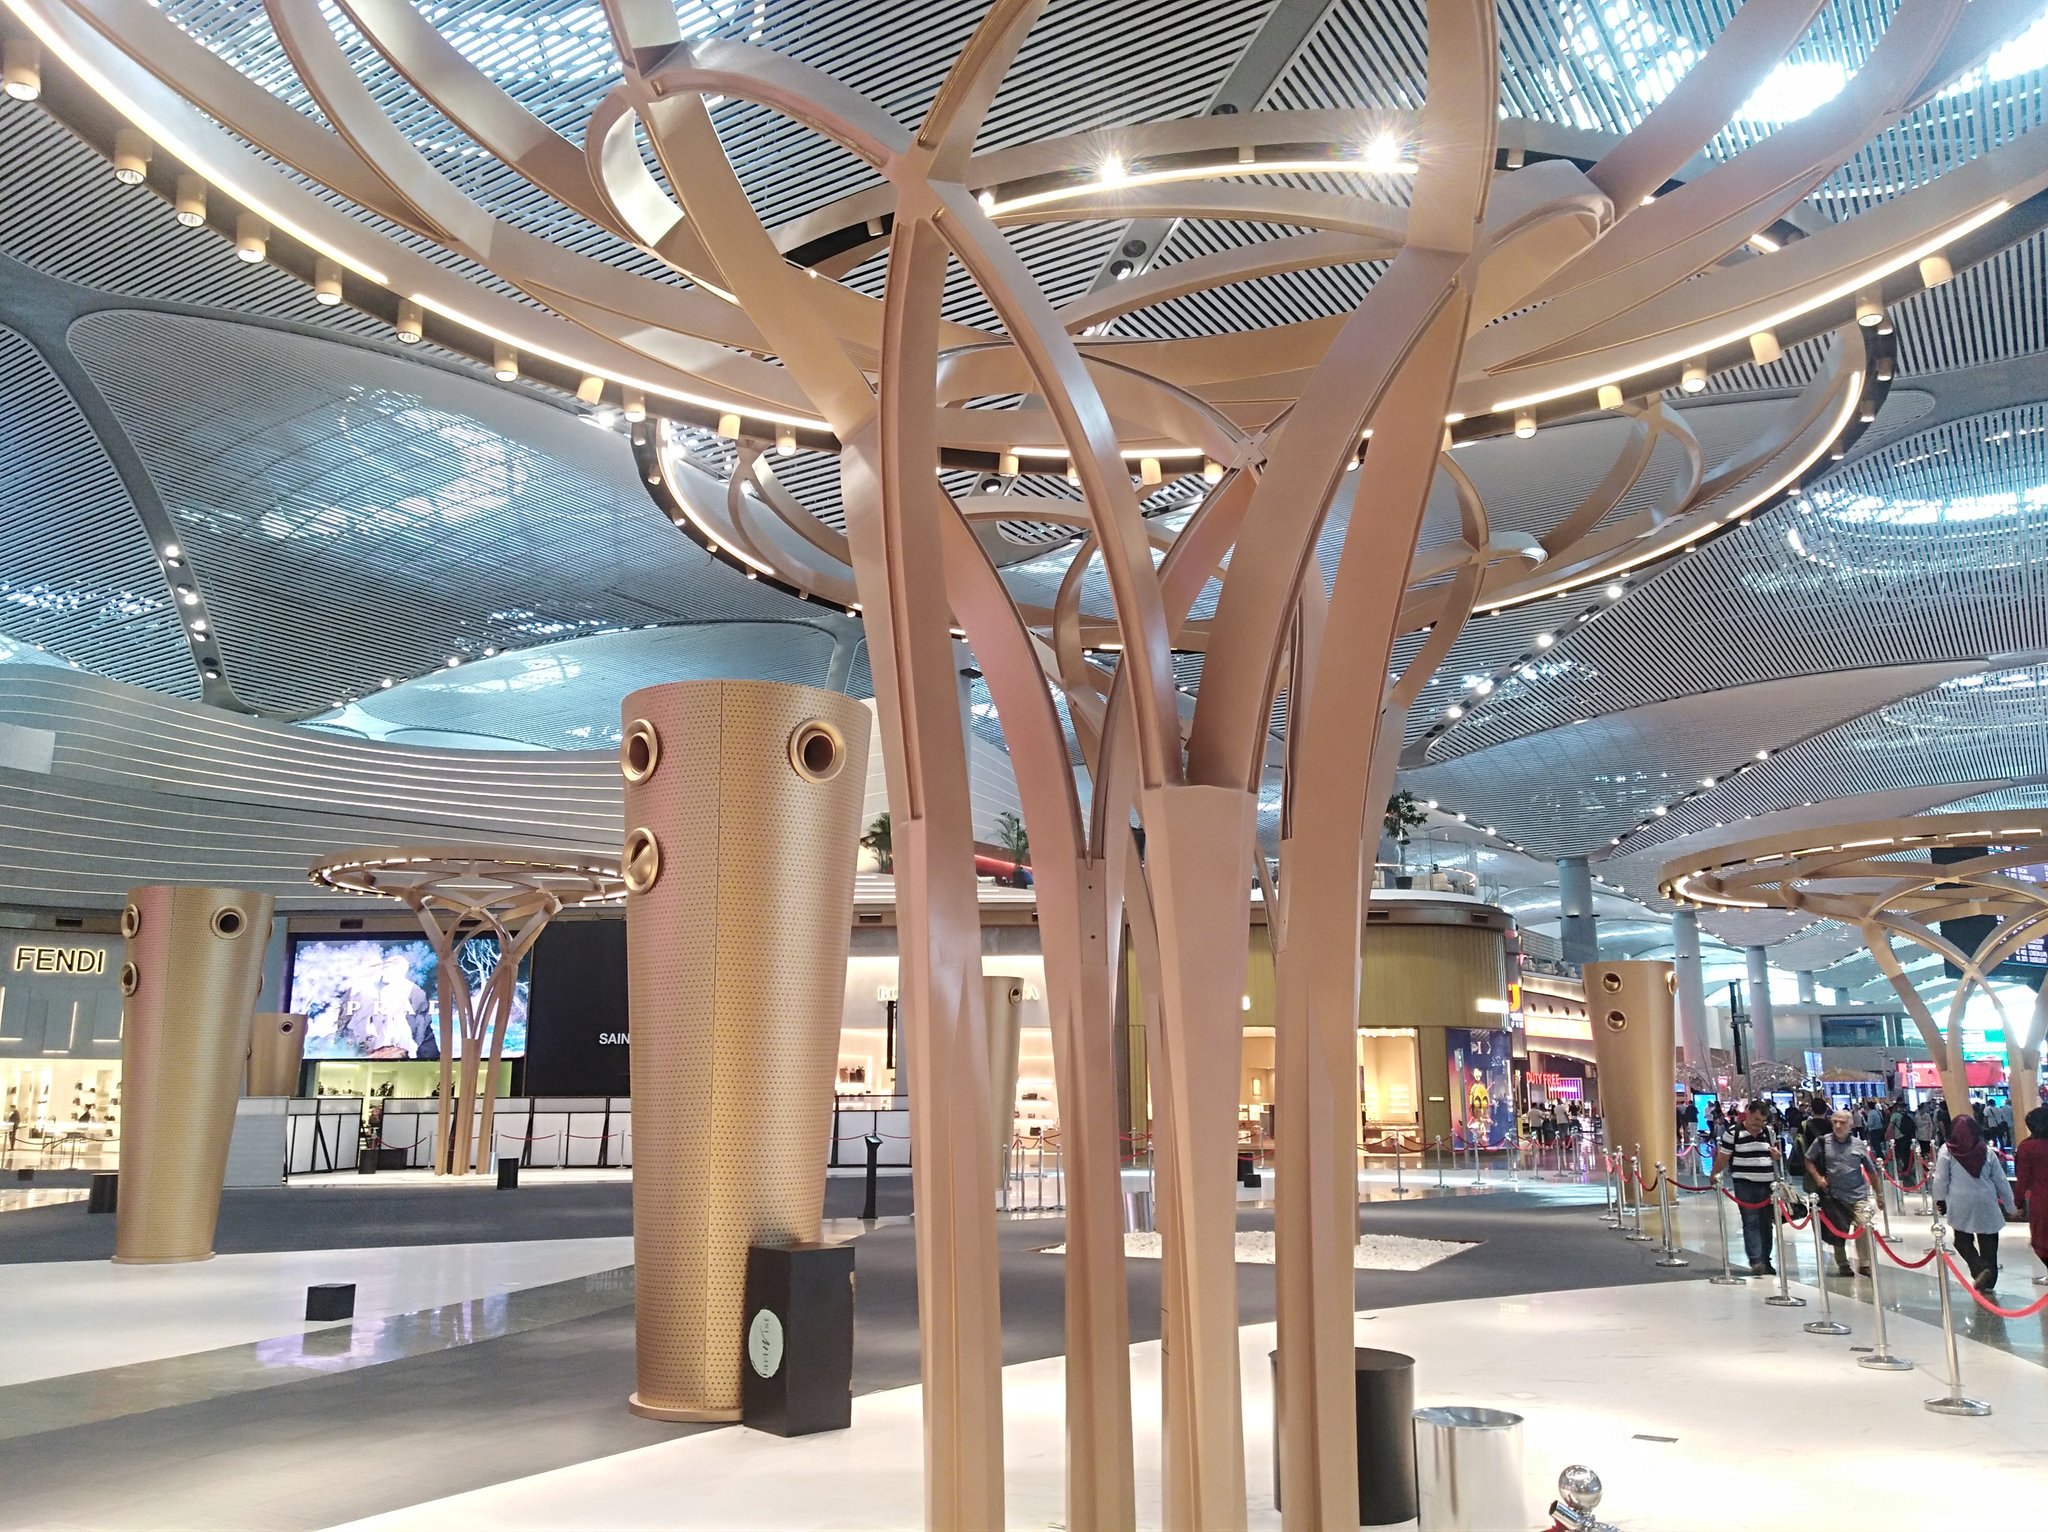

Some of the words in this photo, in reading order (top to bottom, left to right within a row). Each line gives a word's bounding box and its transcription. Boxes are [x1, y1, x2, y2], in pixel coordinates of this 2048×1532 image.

[16, 947, 104, 973] FENDI
[599, 1032, 630, 1045] SAIN
[1526, 1072, 1542, 1085] DUTY
[1543, 1073, 1560, 1086] FREE
